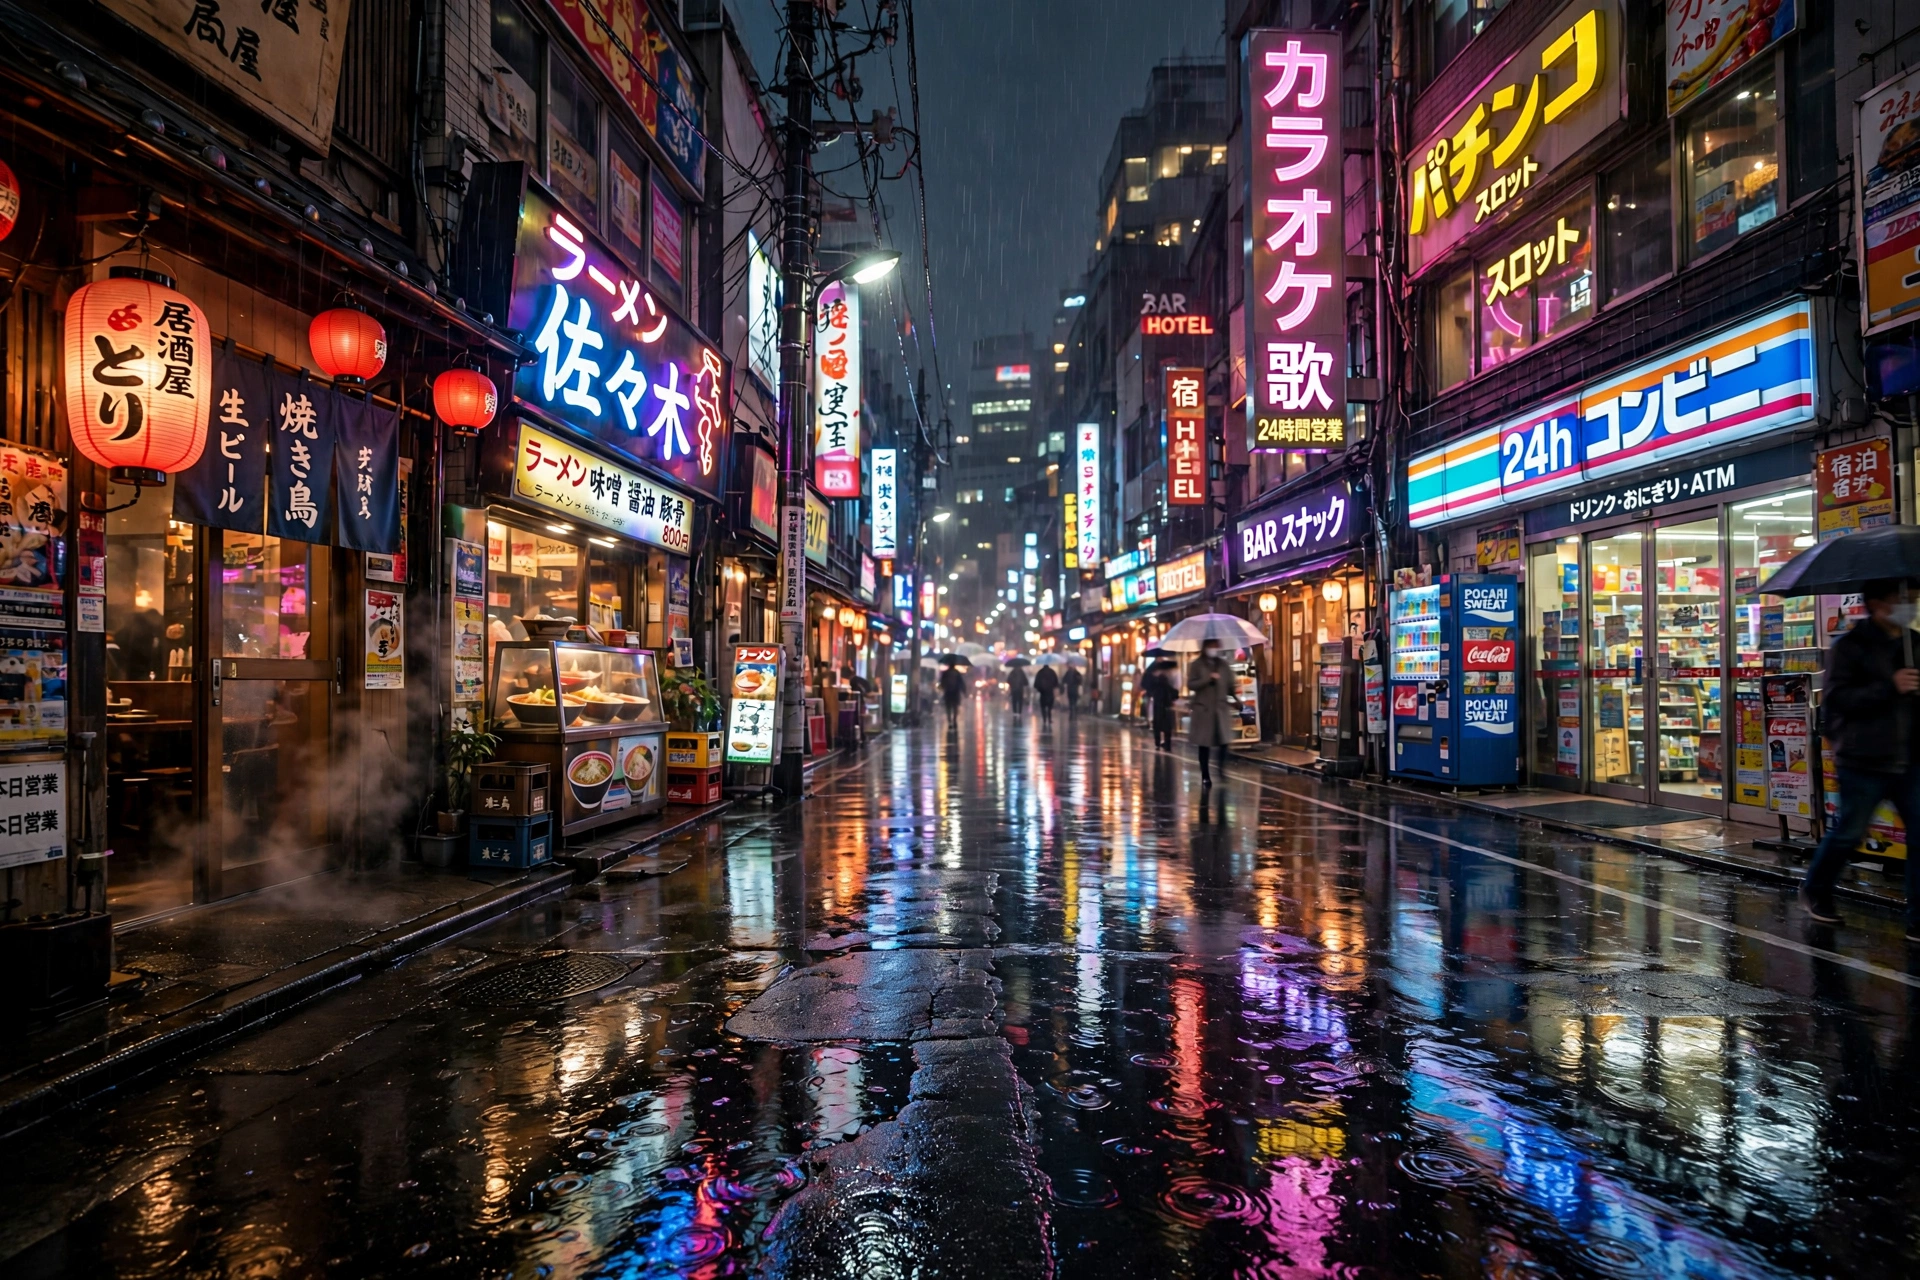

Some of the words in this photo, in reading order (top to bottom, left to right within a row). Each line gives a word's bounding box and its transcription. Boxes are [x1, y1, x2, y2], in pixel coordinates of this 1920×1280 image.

[1410, 9, 1600, 236] パチンコ
[1475, 155, 1538, 223] スロット
[549, 213, 668, 343] ラーメン
[1486, 217, 1579, 306] スロット
[1141, 293, 1186, 314] BAR
[1147, 316, 1213, 334] HOTEL
[154, 301, 195, 399] 居酒屋
[535, 283, 691, 461] 佐々木
[93, 335, 144, 441] とり
[1503, 419, 1572, 486] 24h
[1585, 345, 1762, 458] コンビニ
[218, 388, 250, 514] 生ビール
[279, 392, 319, 529] 焼き鳥
[1258, 417, 1343, 442] 24時間営業
[1831, 448, 1877, 478] 宿泊
[526, 440, 587, 487] ラーメン
[590, 466, 622, 508] 味噌
[628, 480, 655, 519] 醤油
[659, 494, 685, 527] 豚骨
[662, 525, 689, 549] 800円
[1243, 520, 1278, 563] BAR
[1281, 496, 1345, 550] スナック
[1464, 589, 1508, 600] POCARI
[1464, 599, 1507, 610] SWEAT
[739, 649, 776, 661] ラーメン
[1464, 711, 1507, 722] SWEAT
[1465, 699, 1508, 711] POCARI
